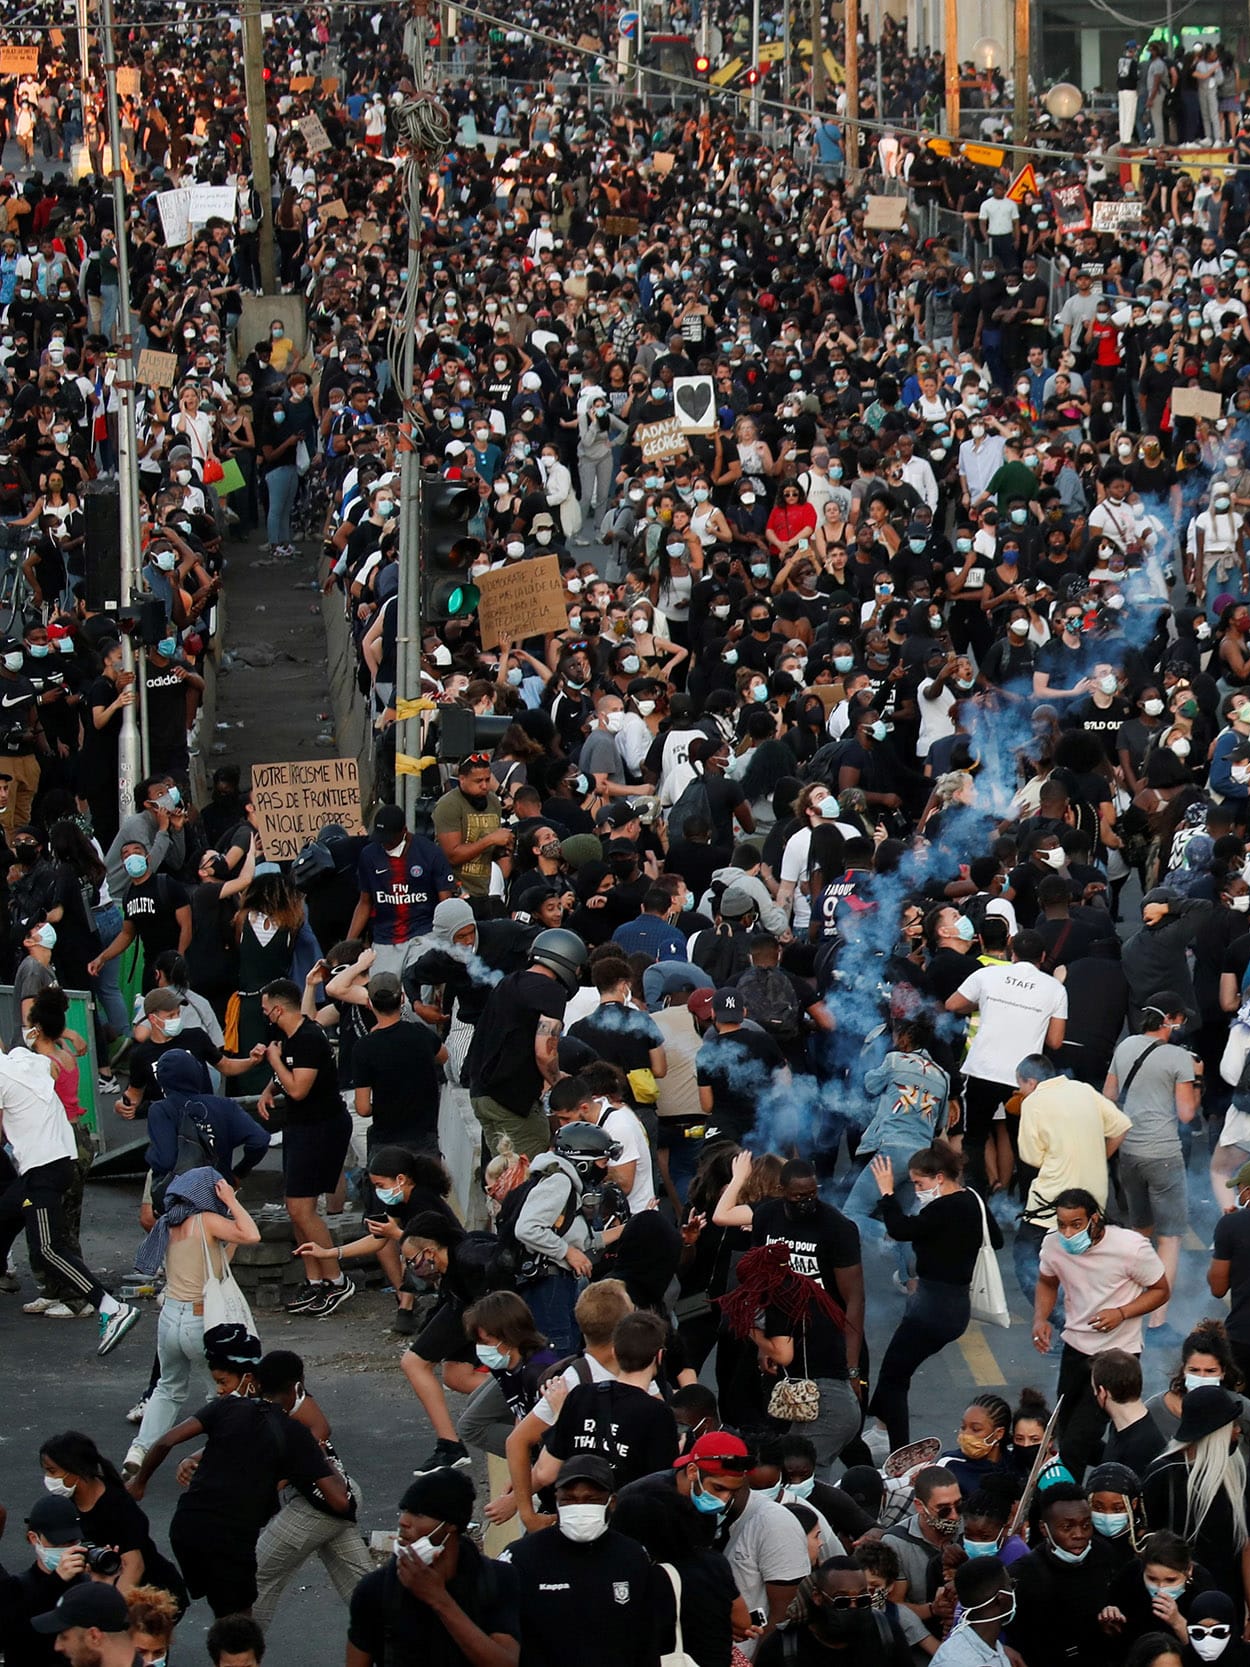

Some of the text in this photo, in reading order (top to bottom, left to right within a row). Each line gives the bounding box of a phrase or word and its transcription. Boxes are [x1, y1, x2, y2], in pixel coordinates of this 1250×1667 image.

[489, 384, 511, 392] MIAMI
[643, 432, 686, 456] GEORGE
[146, 674, 183, 688] adidas
[253, 762, 357, 788] VOTRE RACISME N'A
[257, 788, 360, 810] PAS DE FRONTIERE
[265, 814, 304, 833] NIQUE
[266, 838, 299, 857] -SION
[392, 883, 409, 893] Fly
[376, 891, 428, 905] Emirates
[1005, 976, 1036, 990] STAFF
[795, 1241, 817, 1253] pour
[539, 1583, 571, 1591] Kappa
